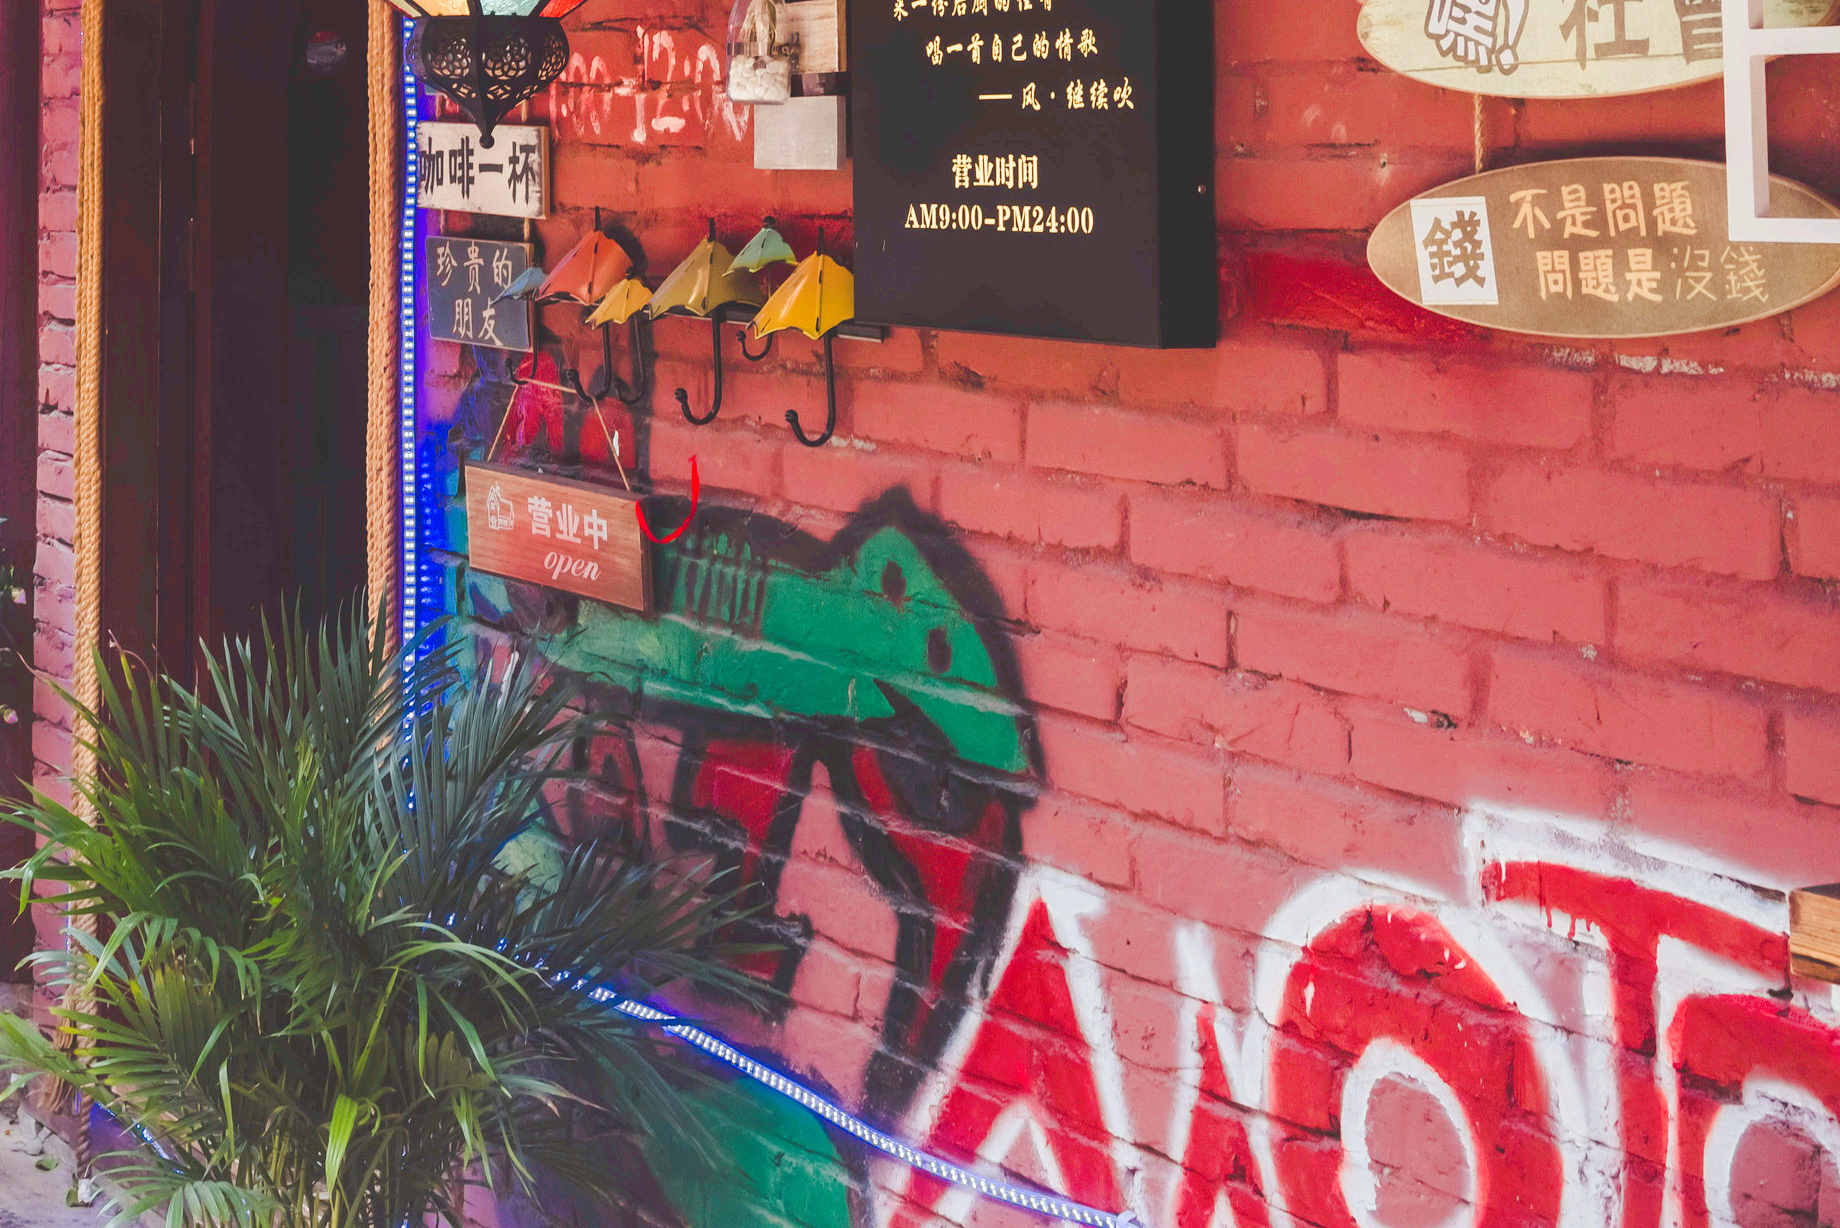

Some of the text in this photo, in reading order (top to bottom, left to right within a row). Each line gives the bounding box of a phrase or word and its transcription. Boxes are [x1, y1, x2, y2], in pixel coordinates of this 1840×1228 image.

[925, 27, 1099, 66] 唱一首自己的情歌
[418, 135, 538, 206] 咖啡一杯
[951, 153, 1040, 190] 营业时间
[904, 202, 1095, 235] AM9:00-PM24:00
[1509, 180, 1699, 240] 不是問題
[435, 243, 515, 295] 珍贵的
[1422, 209, 1487, 290] 錢
[451, 298, 504, 347] 朋友
[527, 495, 610, 551] 营业中
[543, 549, 602, 582] open
